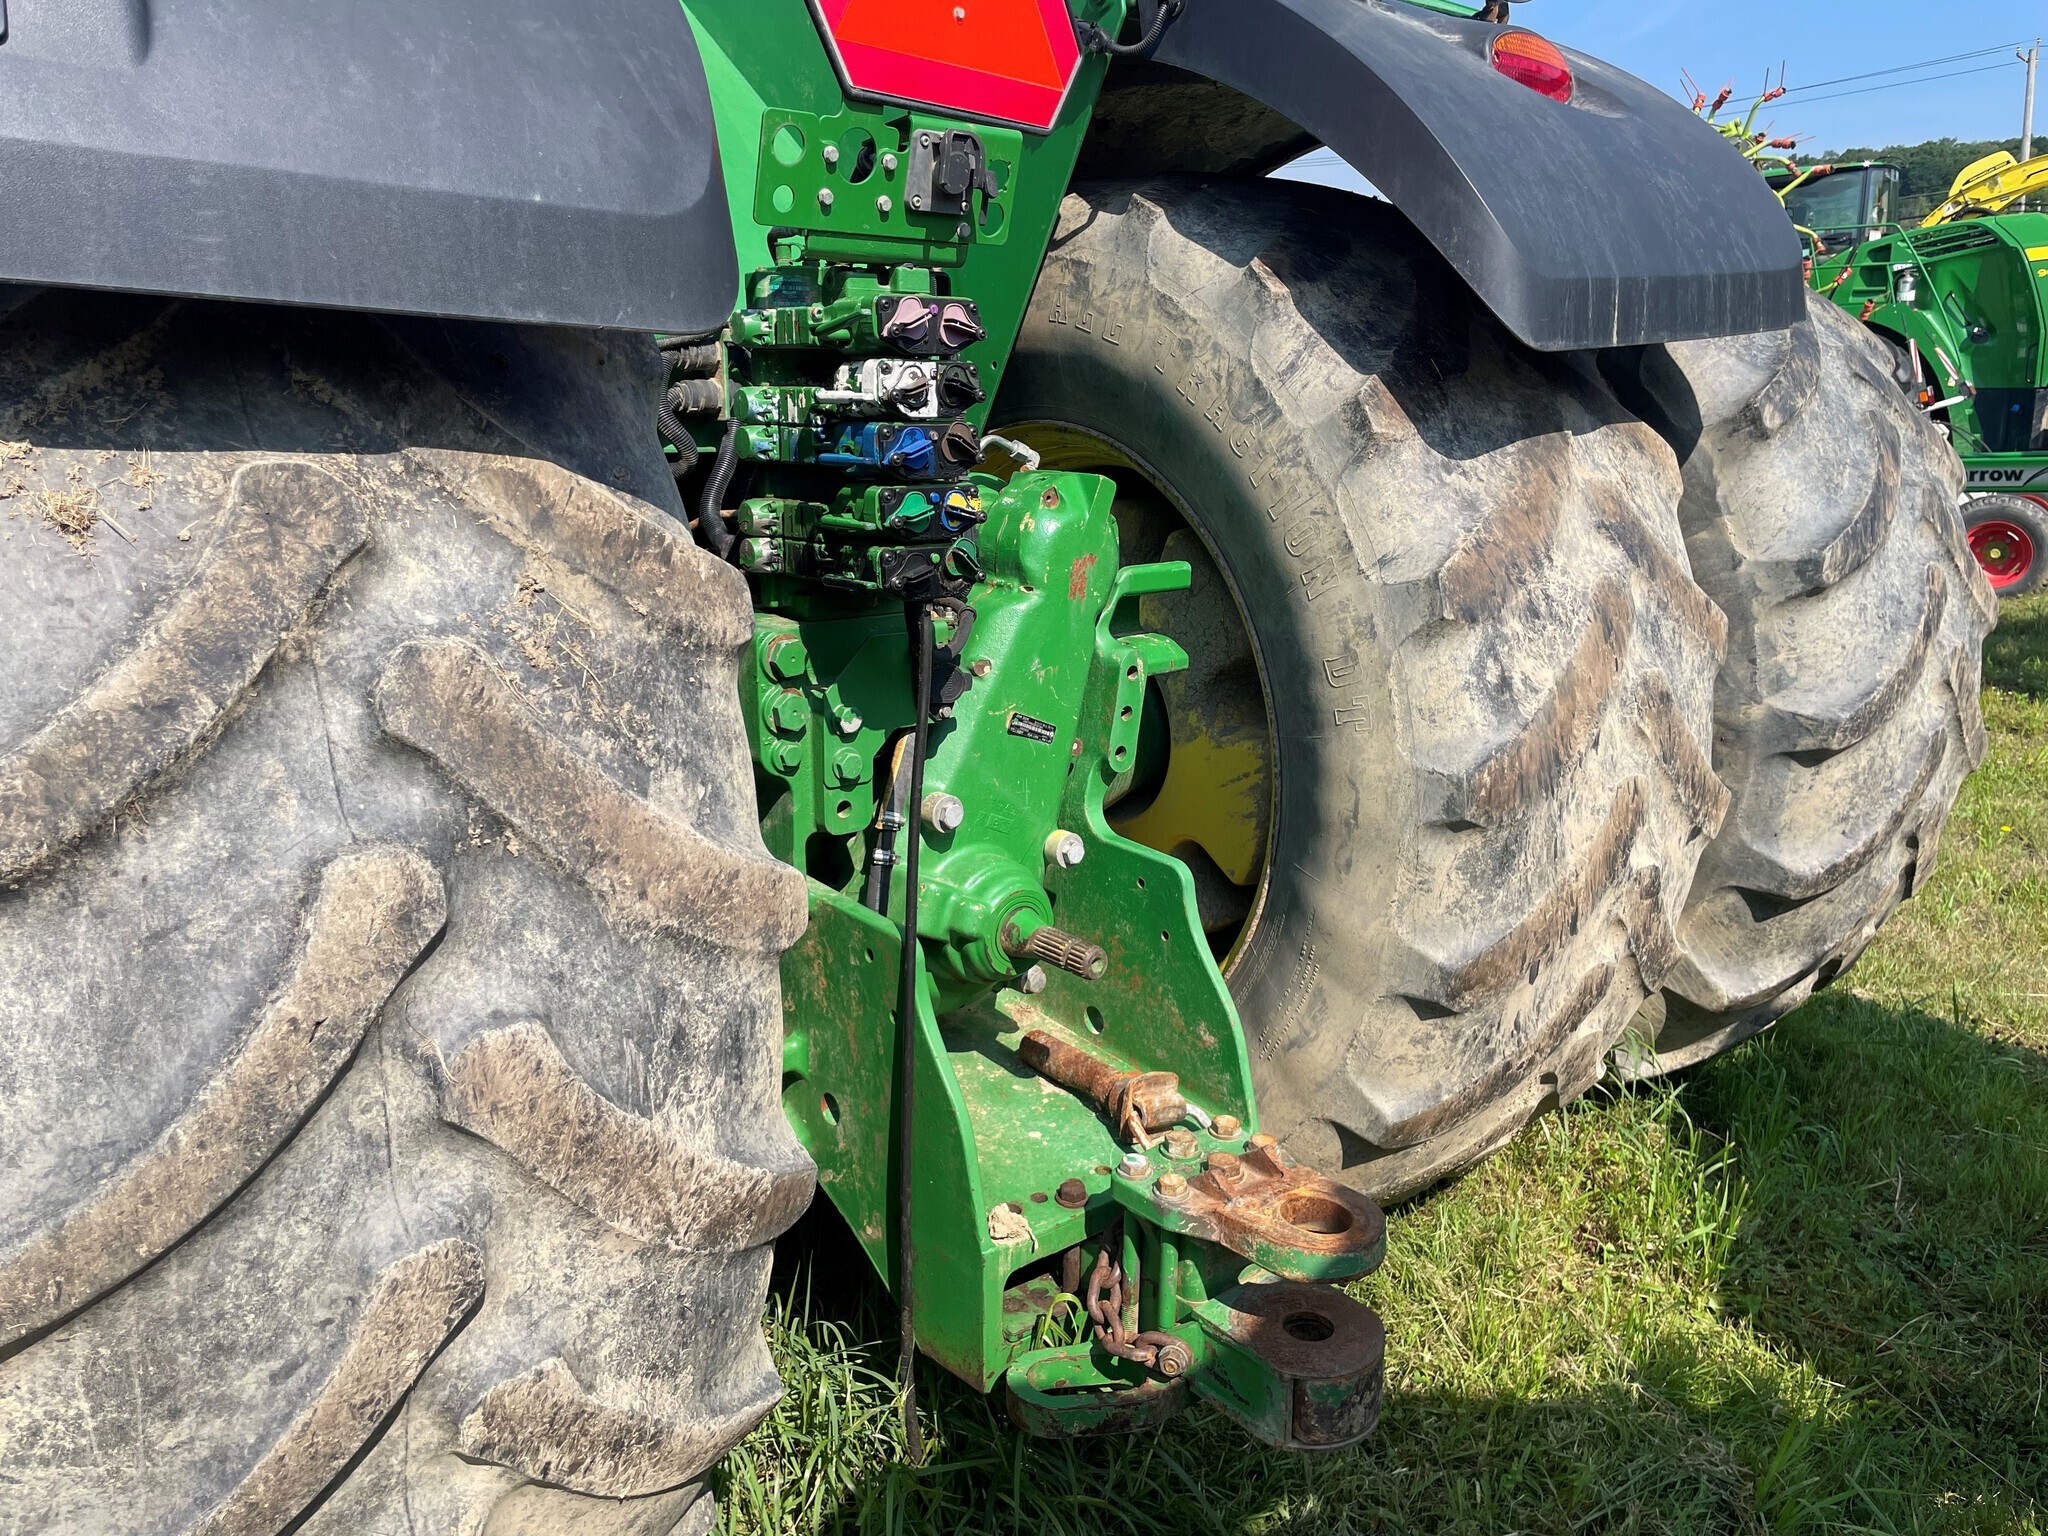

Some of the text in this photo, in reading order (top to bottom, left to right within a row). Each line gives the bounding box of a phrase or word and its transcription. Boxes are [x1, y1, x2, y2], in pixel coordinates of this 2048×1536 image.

[1049, 283, 1124, 346] ALL
[1154, 324, 1341, 601] TRACTION
[1966, 468, 2025, 483] rrow
